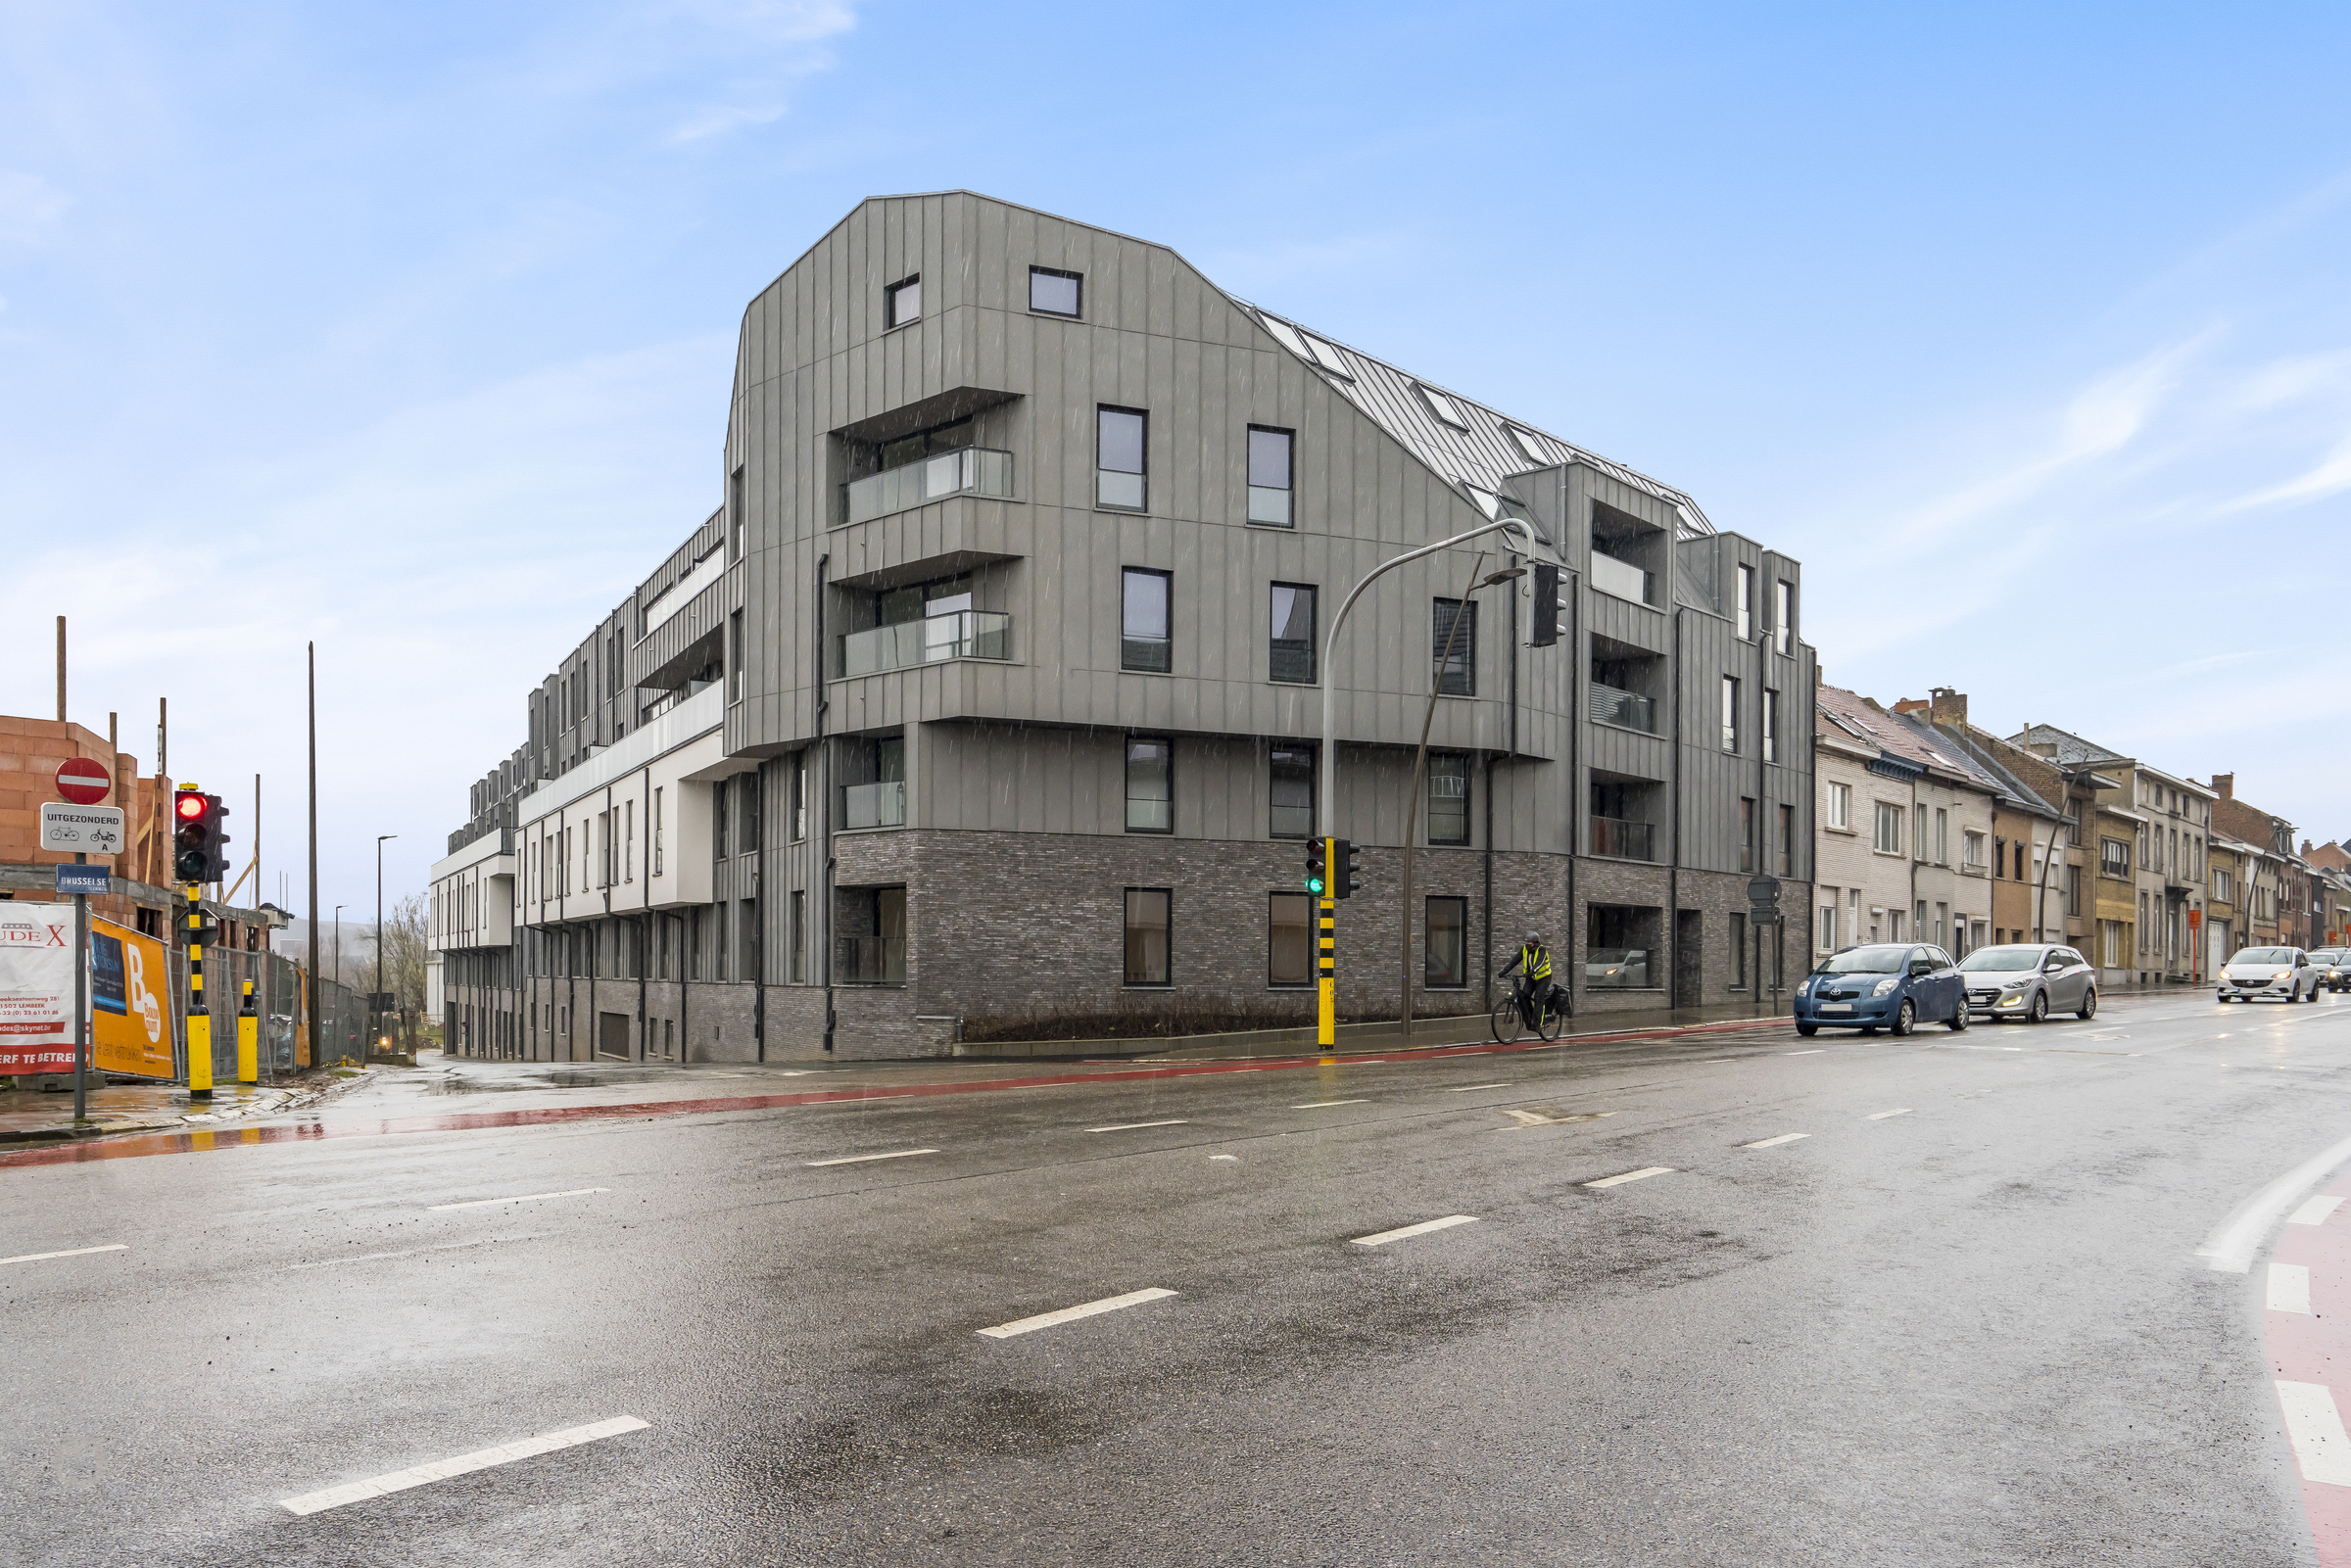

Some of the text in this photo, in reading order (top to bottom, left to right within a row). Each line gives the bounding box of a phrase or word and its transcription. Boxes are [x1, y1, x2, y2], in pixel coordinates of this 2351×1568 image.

[47, 814, 120, 825] UITGEZONDERD
[61, 877, 107, 886] BRUSSELSE
[23, 1054, 36, 1064] TE
